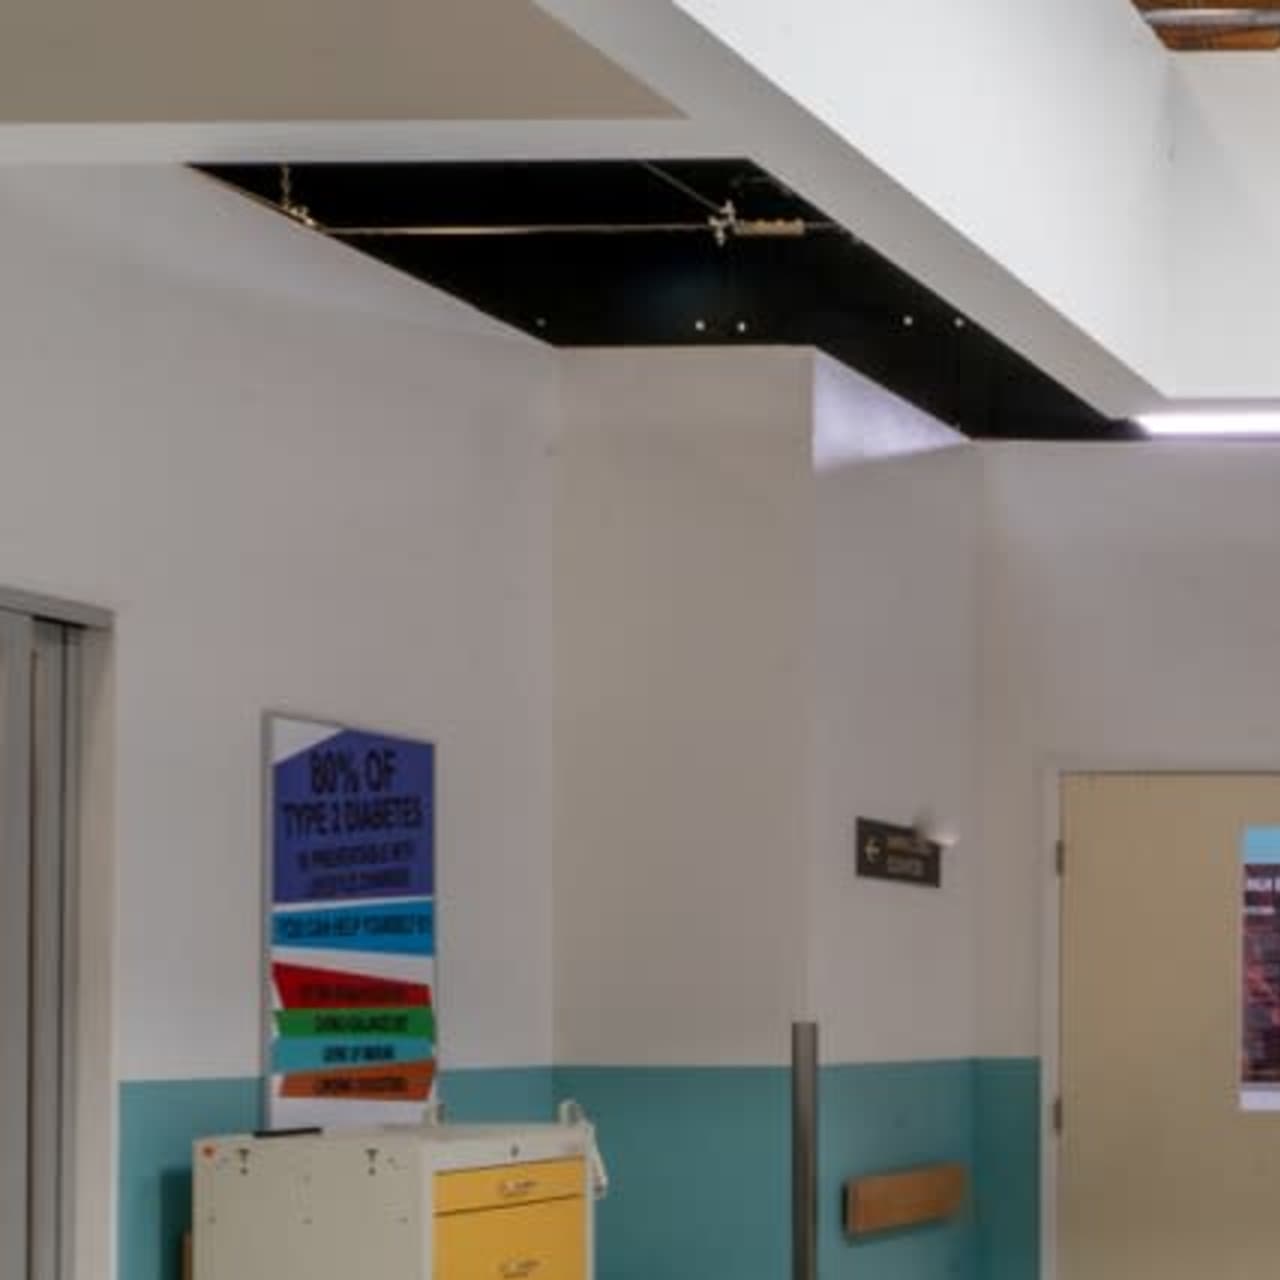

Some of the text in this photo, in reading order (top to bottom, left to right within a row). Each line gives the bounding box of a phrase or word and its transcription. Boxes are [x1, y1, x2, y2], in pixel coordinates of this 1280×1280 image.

[309, 747, 398, 795] 80% OF
[282, 801, 327, 839] TYPE
[345, 796, 423, 833] DIABETES
